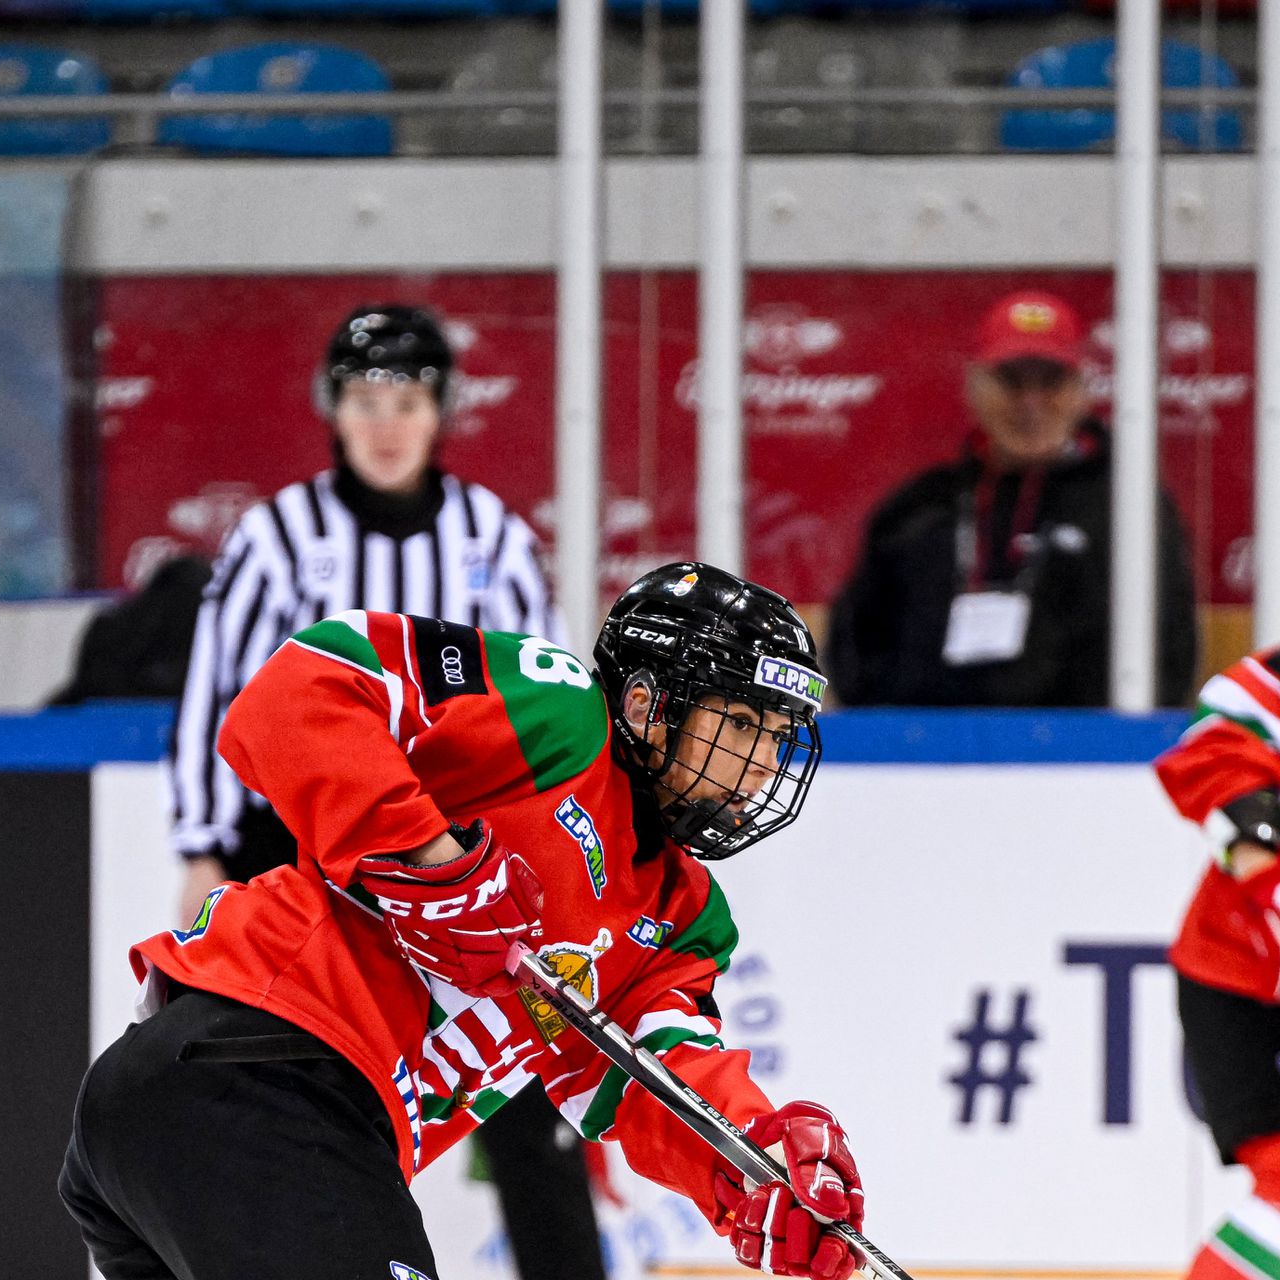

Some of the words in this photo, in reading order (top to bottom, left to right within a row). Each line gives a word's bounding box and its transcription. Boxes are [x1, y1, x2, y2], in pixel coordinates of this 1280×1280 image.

[624, 625, 677, 646] CCM
[375, 859, 509, 921] CCM
[719, 1117, 743, 1138] FLEX
[840, 1222, 902, 1274] BAUER
